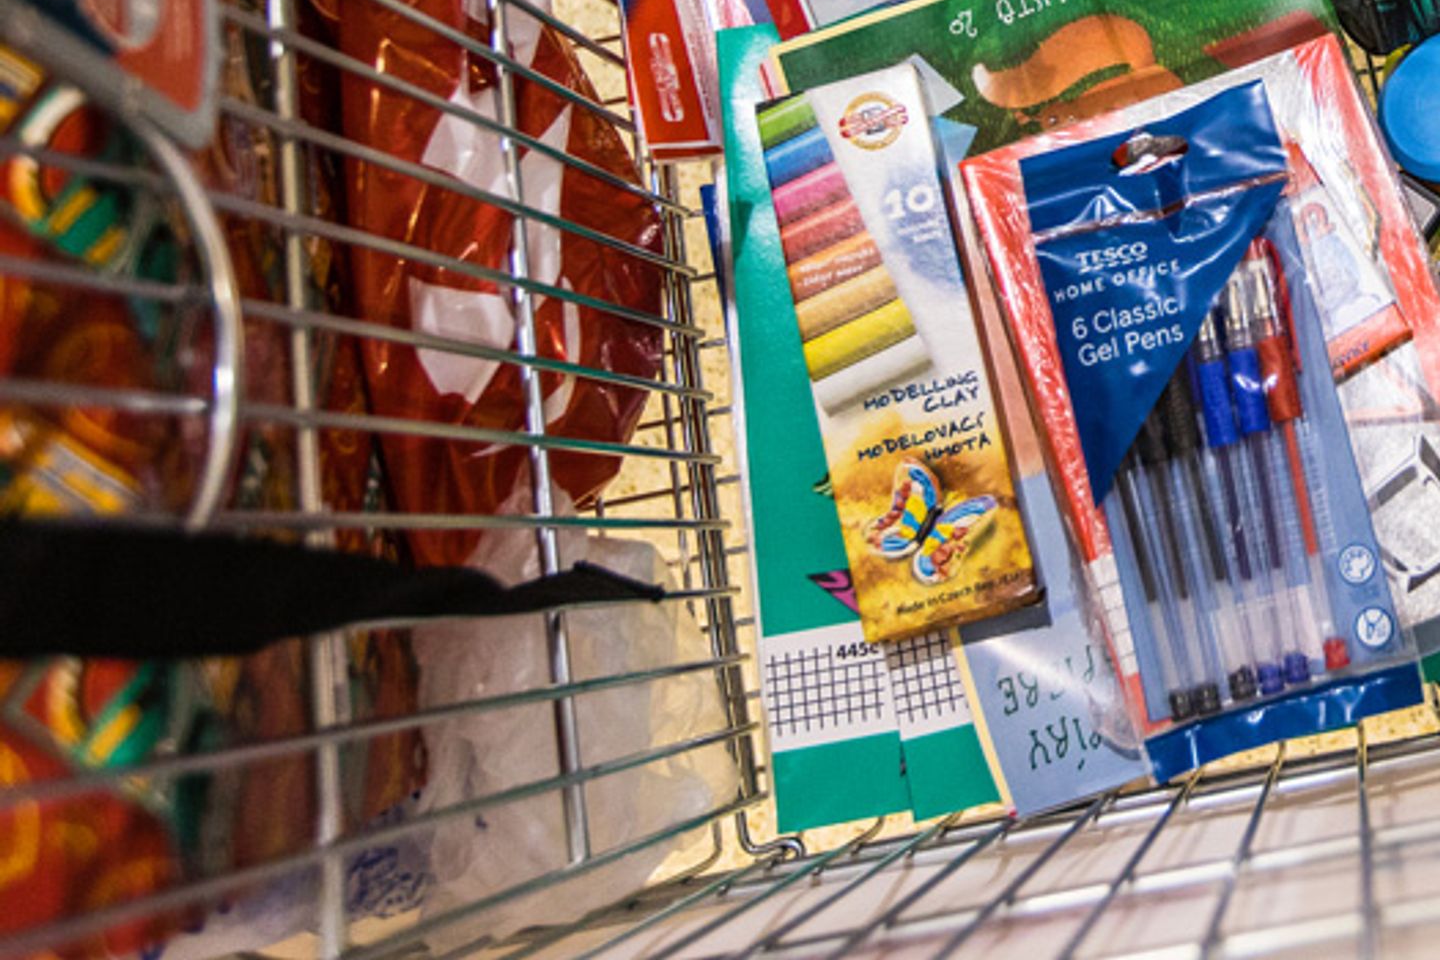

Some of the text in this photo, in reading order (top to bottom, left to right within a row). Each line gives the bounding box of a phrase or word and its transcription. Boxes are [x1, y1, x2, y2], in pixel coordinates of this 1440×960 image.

[949, 10, 977, 38] 20
[884, 183, 936, 220] 10
[1075, 241, 1150, 274] TESCO
[1053, 259, 1182, 304] HOME OFFICE
[1072, 295, 1179, 341] 6 Classic
[1077, 324, 1184, 368] Gel Pens
[862, 370, 979, 412] MODELLING
[922, 384, 980, 414] CLAY
[856, 411, 986, 463] MODELOVACÍ
[923, 433, 992, 463] HMOTA
